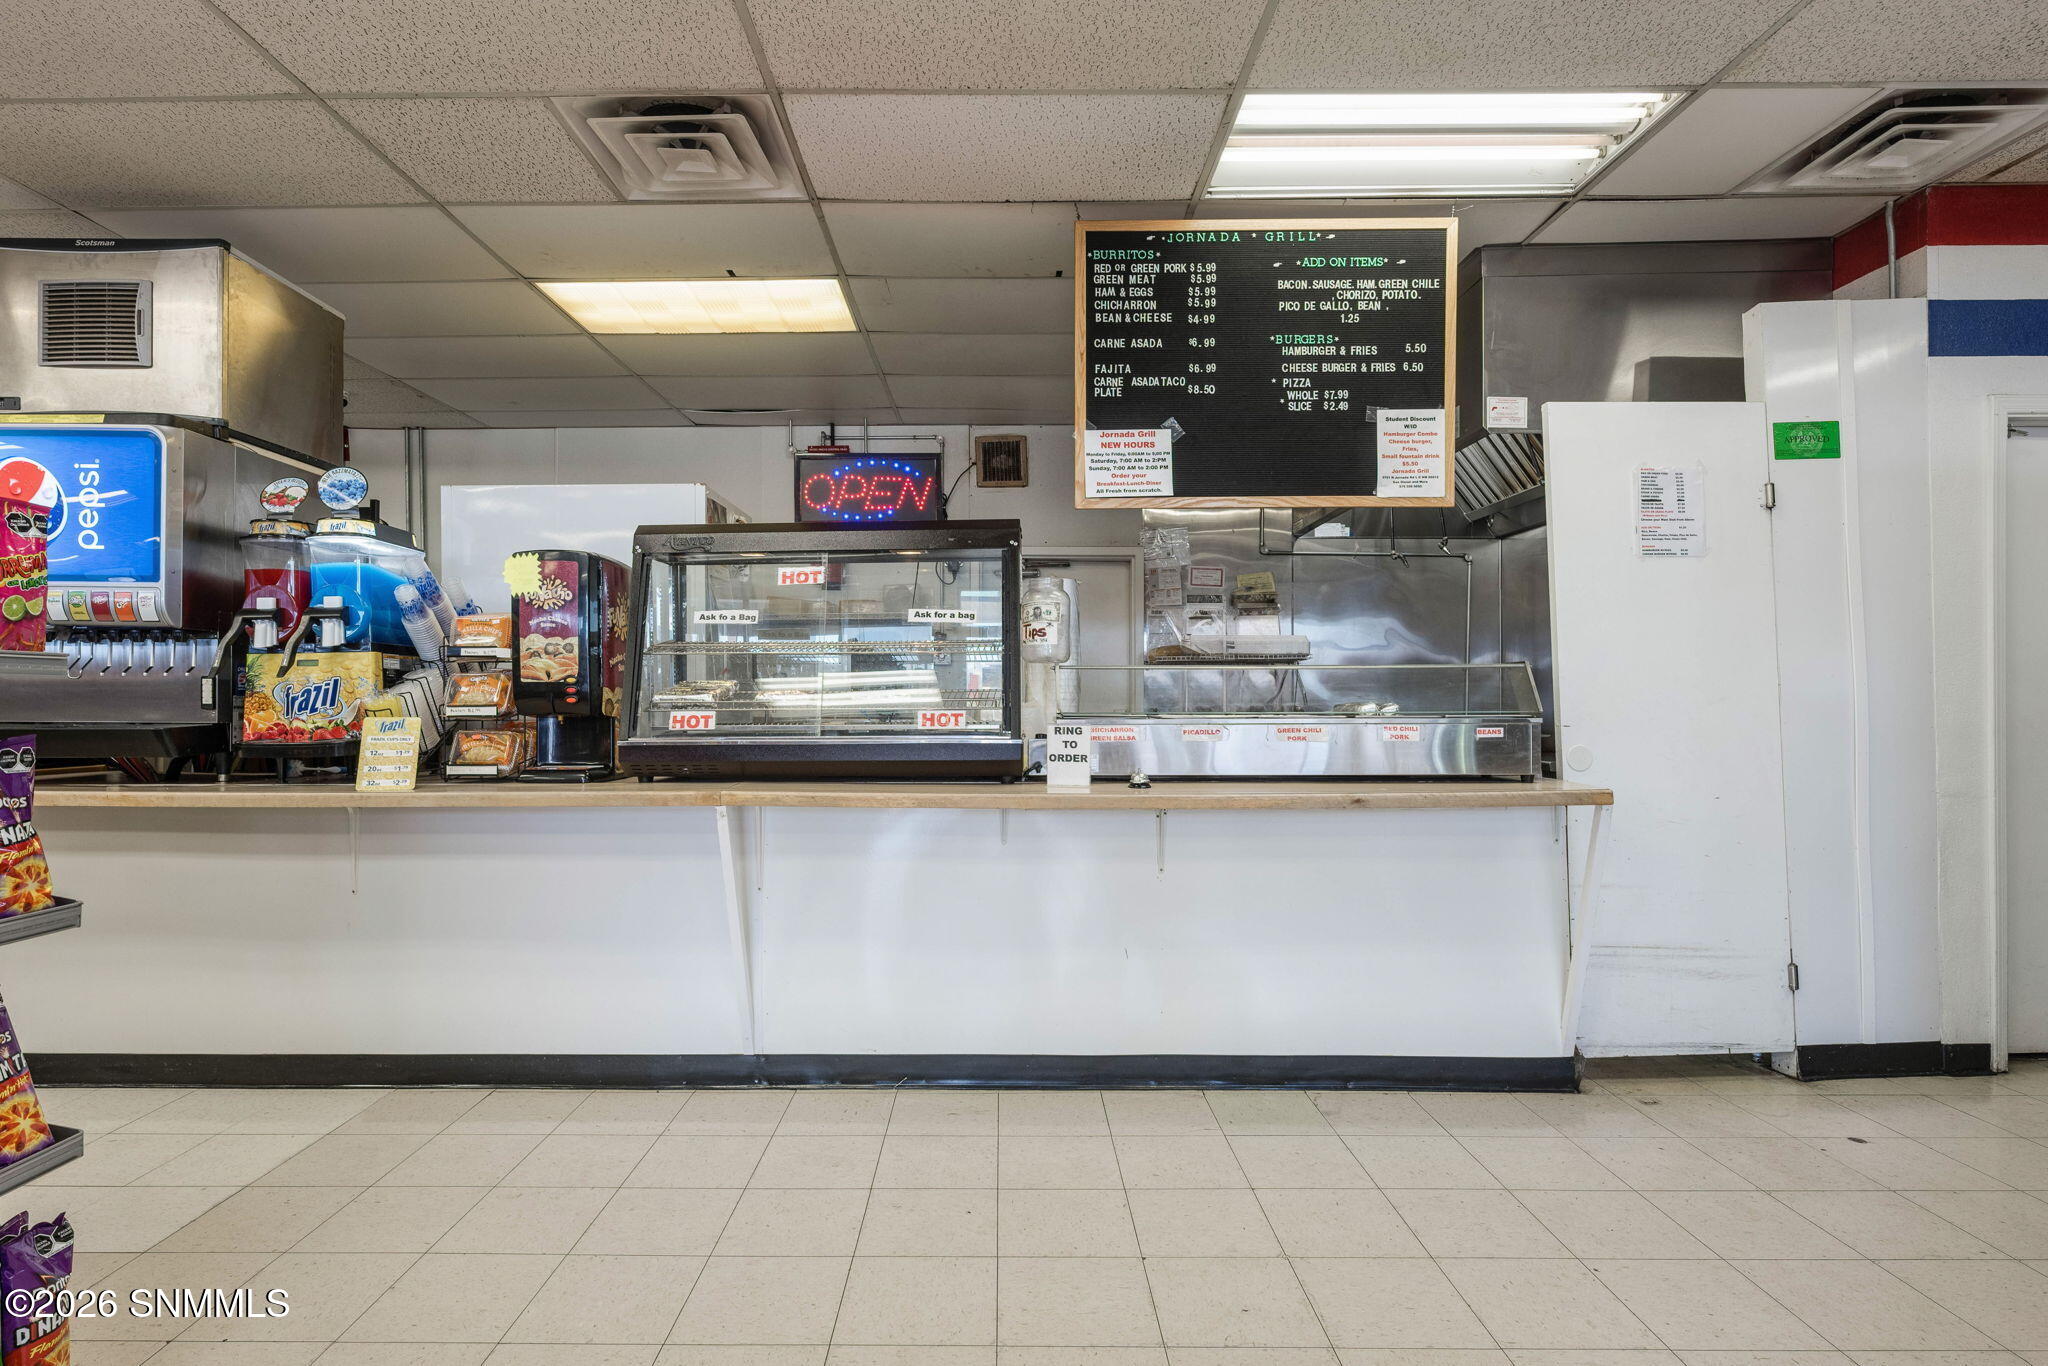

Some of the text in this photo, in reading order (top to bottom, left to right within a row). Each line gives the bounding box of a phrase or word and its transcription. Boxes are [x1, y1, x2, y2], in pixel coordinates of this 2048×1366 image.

[1167, 231, 1316, 243] JORNADA GRILL
[1093, 250, 1155, 260] BURRITOS
[1302, 257, 1384, 267] ADD ON ITEMS
[1094, 264, 1111, 273] RED
[1131, 264, 1160, 273] GREEN
[1164, 264, 1187, 273] PORK
[1190, 263, 1216, 272] $5.99
[1094, 274, 1217, 284] GREEN MEAT $5.99
[1412, 279, 1440, 289] CHILE
[1095, 287, 1216, 297] HAM & EGGS $5.99
[1094, 298, 1216, 310] CHICHARRON $5.99
[1279, 302, 1300, 311] PICO
[1304, 302, 1316, 311] DE
[1095, 313, 1122, 323] BEAN
[1188, 314, 1215, 324] $4.99
[1340, 313, 1360, 323] 1.25
[1094, 338, 1216, 348] CARNE ASADA $6.99
[1275, 335, 1333, 344] BURGERS
[1282, 344, 1427, 355] HAMBURGER & FRIES 5.50
[1095, 363, 1216, 374] FAJITA $6.99
[1282, 362, 1424, 372] CHEESE BURGER & FRIES 6.50
[1094, 377, 1124, 387] CARNE
[1188, 385, 1215, 394] $8.50
[1283, 378, 1311, 388] PIZZA
[1094, 387, 1122, 397] PLATE
[1287, 390, 1349, 400] WHOLE $7.99
[1288, 401, 1349, 411] SLICE $2.49
[803, 473, 934, 511] OPEN
[74, 463, 105, 550] pepsi
[330, 521, 347, 531] frazil
[781, 571, 822, 585] HOT
[699, 613, 717, 621] Ask
[719, 613, 728, 621] fo
[739, 613, 756, 622] Bag
[958, 612, 975, 620] bag
[1023, 624, 1047, 640] Tips
[284, 677, 341, 720] frazil
[672, 715, 713, 729] HOT
[921, 713, 963, 726] HOT
[380, 718, 405, 733] frazil
[1054, 726, 1083, 735] RING
[1062, 741, 1078, 749] TO
[1049, 754, 1088, 762] ORDER
